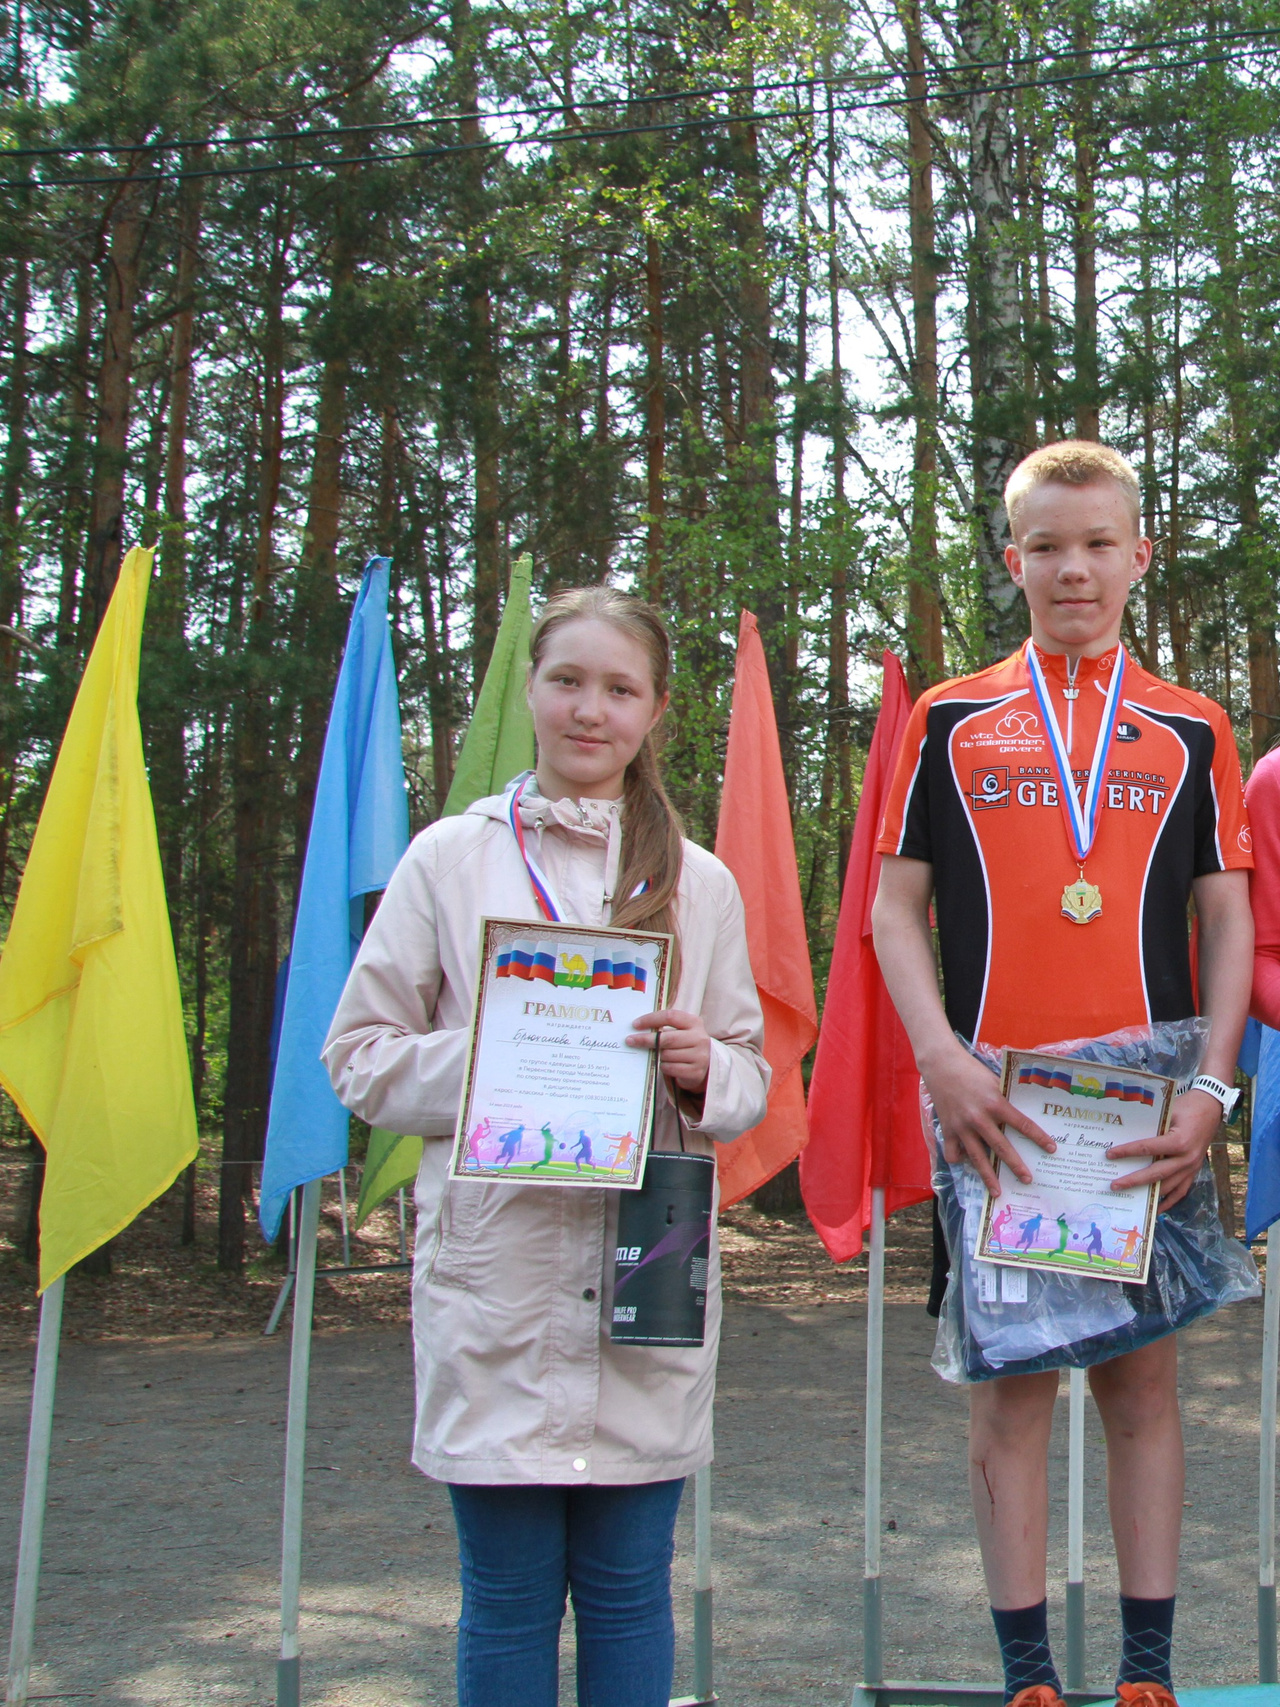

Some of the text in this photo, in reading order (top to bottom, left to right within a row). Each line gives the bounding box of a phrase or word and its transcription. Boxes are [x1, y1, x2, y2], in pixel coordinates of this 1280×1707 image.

[1078, 896, 1084, 906] 1
[523, 1001, 613, 1023] ГРАМОТА
[547, 1022, 591, 1030] награждается
[580, 1035, 621, 1051] Карина
[1043, 1103, 1123, 1126] ГРАМОТА
[1064, 1122, 1104, 1131] награждается
